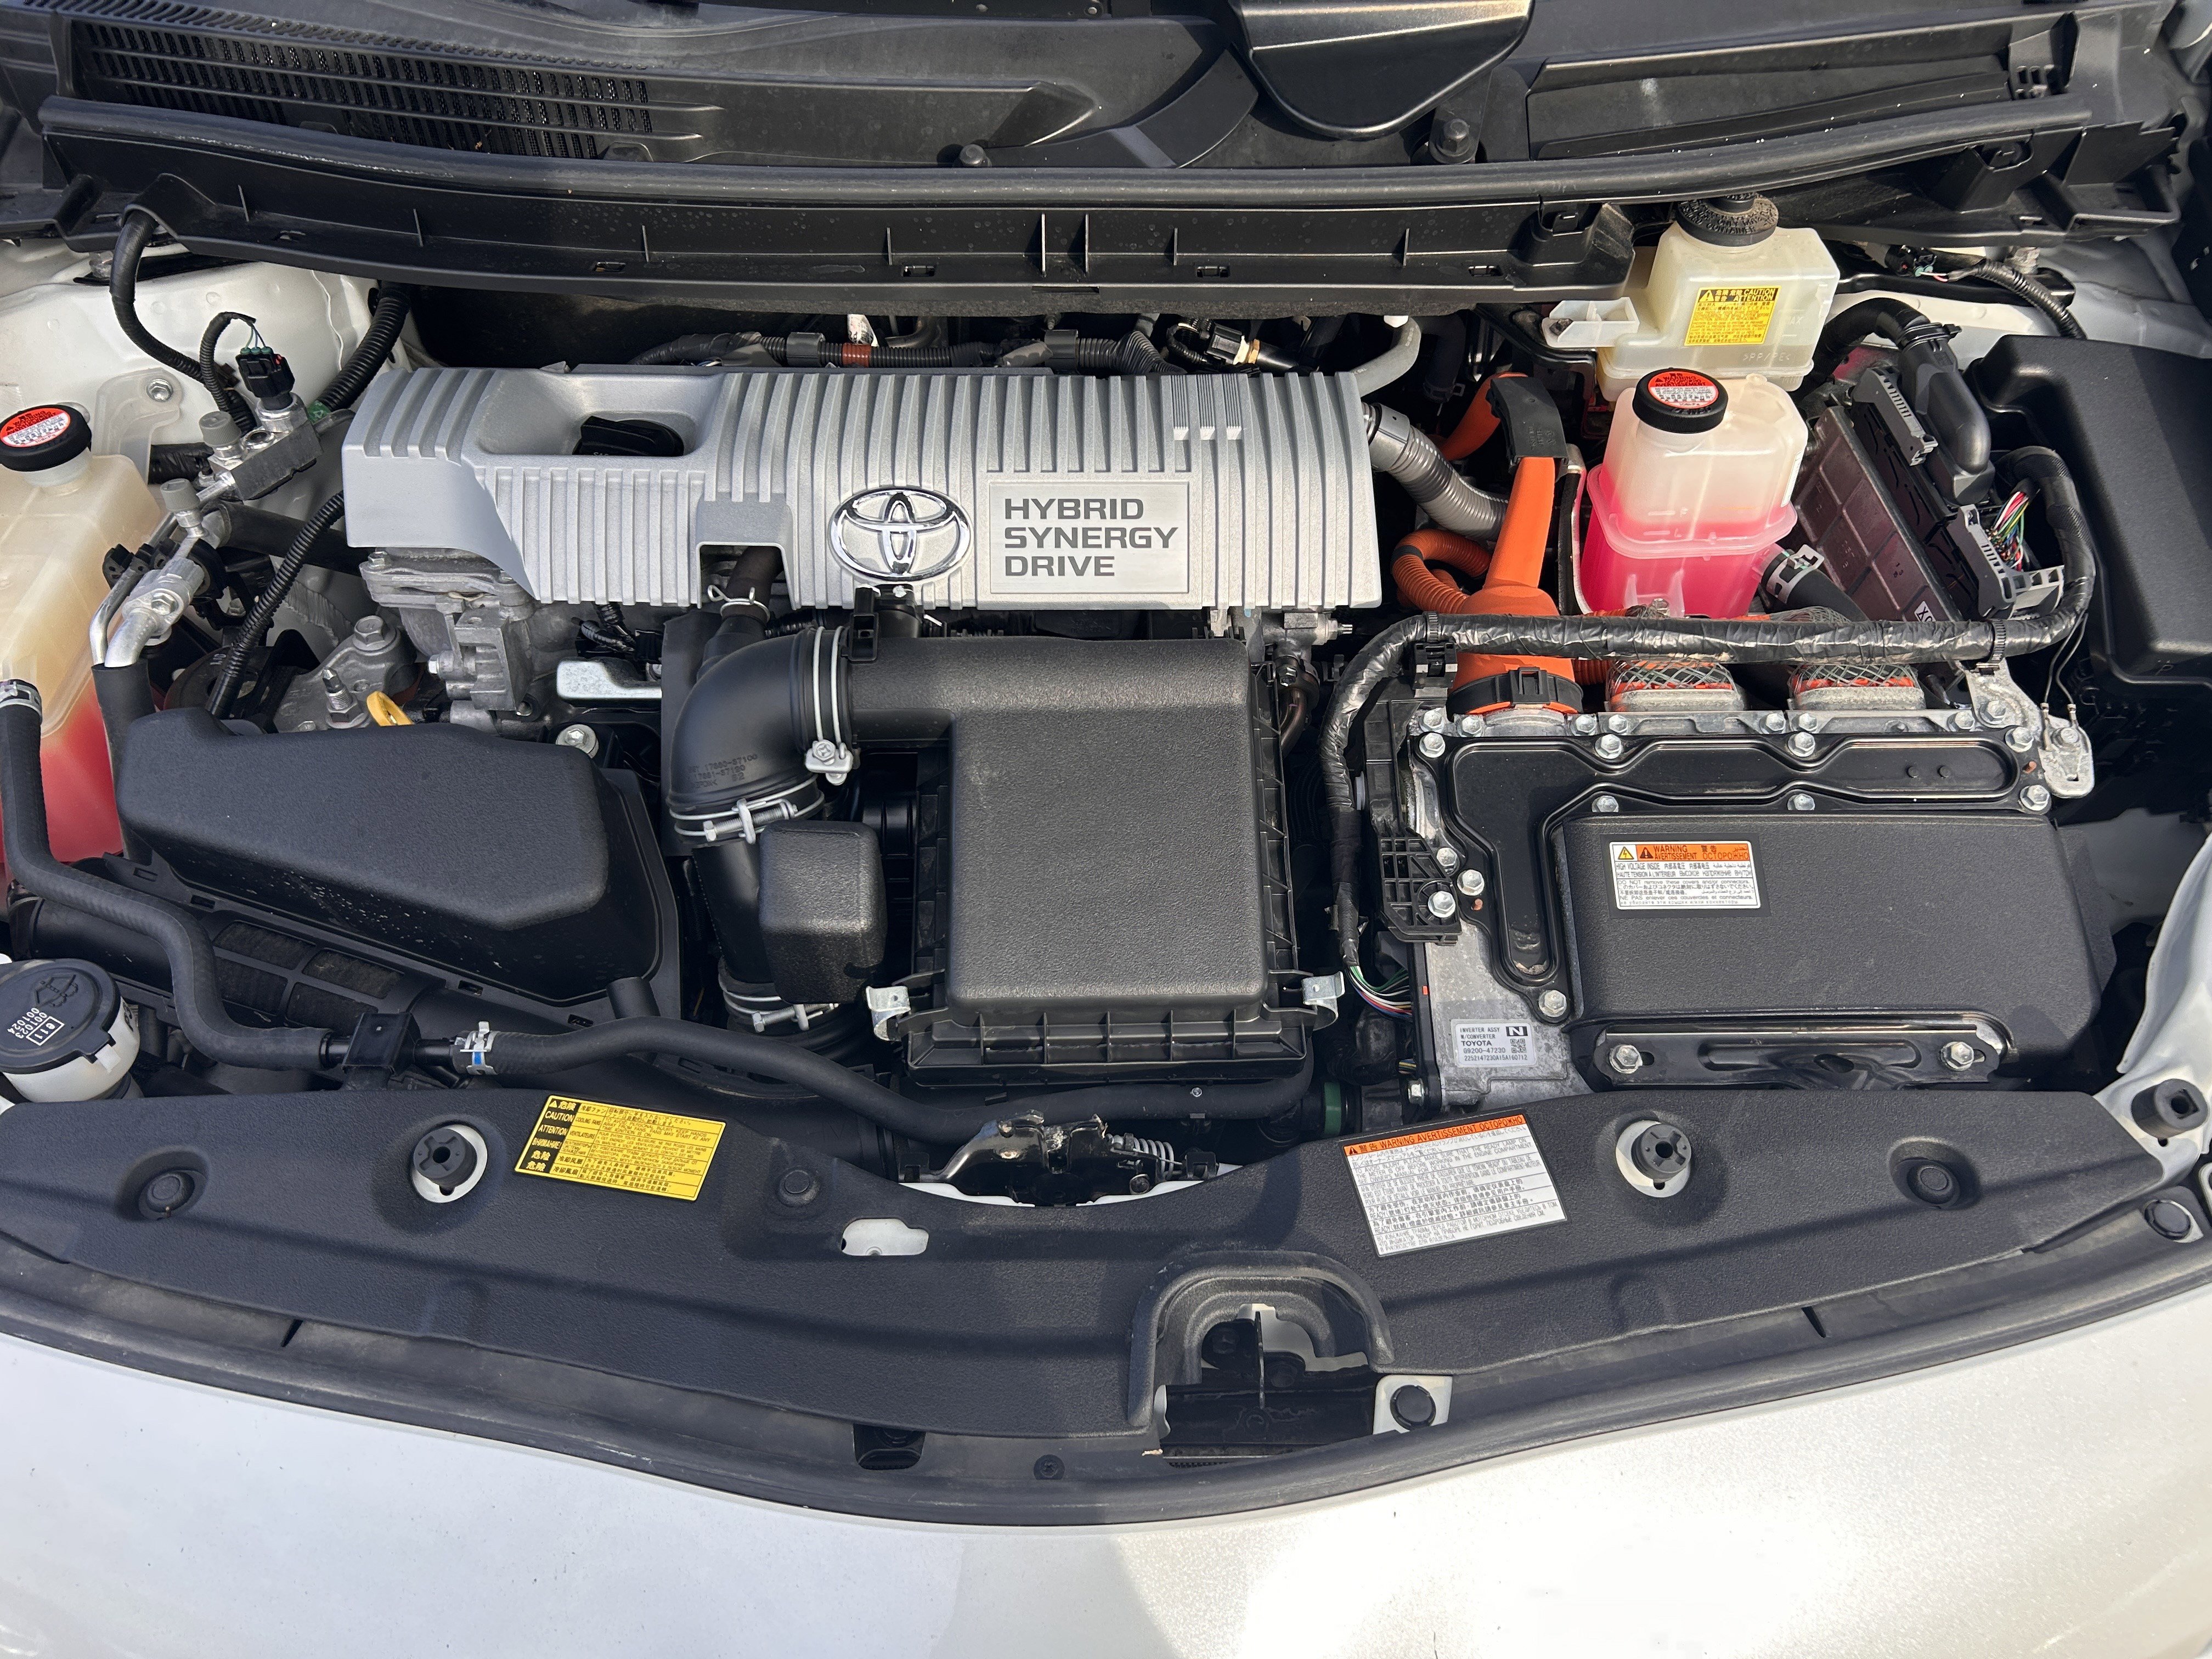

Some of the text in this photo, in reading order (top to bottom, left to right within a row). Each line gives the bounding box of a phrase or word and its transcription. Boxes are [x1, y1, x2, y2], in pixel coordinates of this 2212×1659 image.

[1005, 498, 1143, 520] HYBRID
[1005, 527, 1178, 549] SYNERGY
[1005, 556, 1115, 577] DRIVE
[7, 1007, 40, 1034] 001024
[15, 1012, 47, 1039] 001023
[544, 1110, 575, 1122] CAUTION
[1479, 1116, 1523, 1131] ОСТОРОЖНО
[537, 1123, 569, 1136] ATTENTION
[569, 1130, 596, 1139] VENTILATEURS
[1379, 1136, 1415, 1149] WARNING
[1415, 1124, 1477, 1142] AVERTISSEMENT
[531, 1137, 563, 1149] ВНИМАНИЕ!
[1358, 1142, 1378, 1152] 警告
[1364, 1164, 1380, 1172] AVOID
[1403, 1156, 1422, 1165] PLEASE
[1483, 1142, 1500, 1150] READY
[1407, 1161, 1427, 1170] BEFORE
[1429, 1156, 1453, 1166] WORKING
[1474, 1149, 1493, 1158] ENGINE
[1369, 1173, 1393, 1183] OWNER'S
[1394, 1169, 1417, 1178] MANUAL
